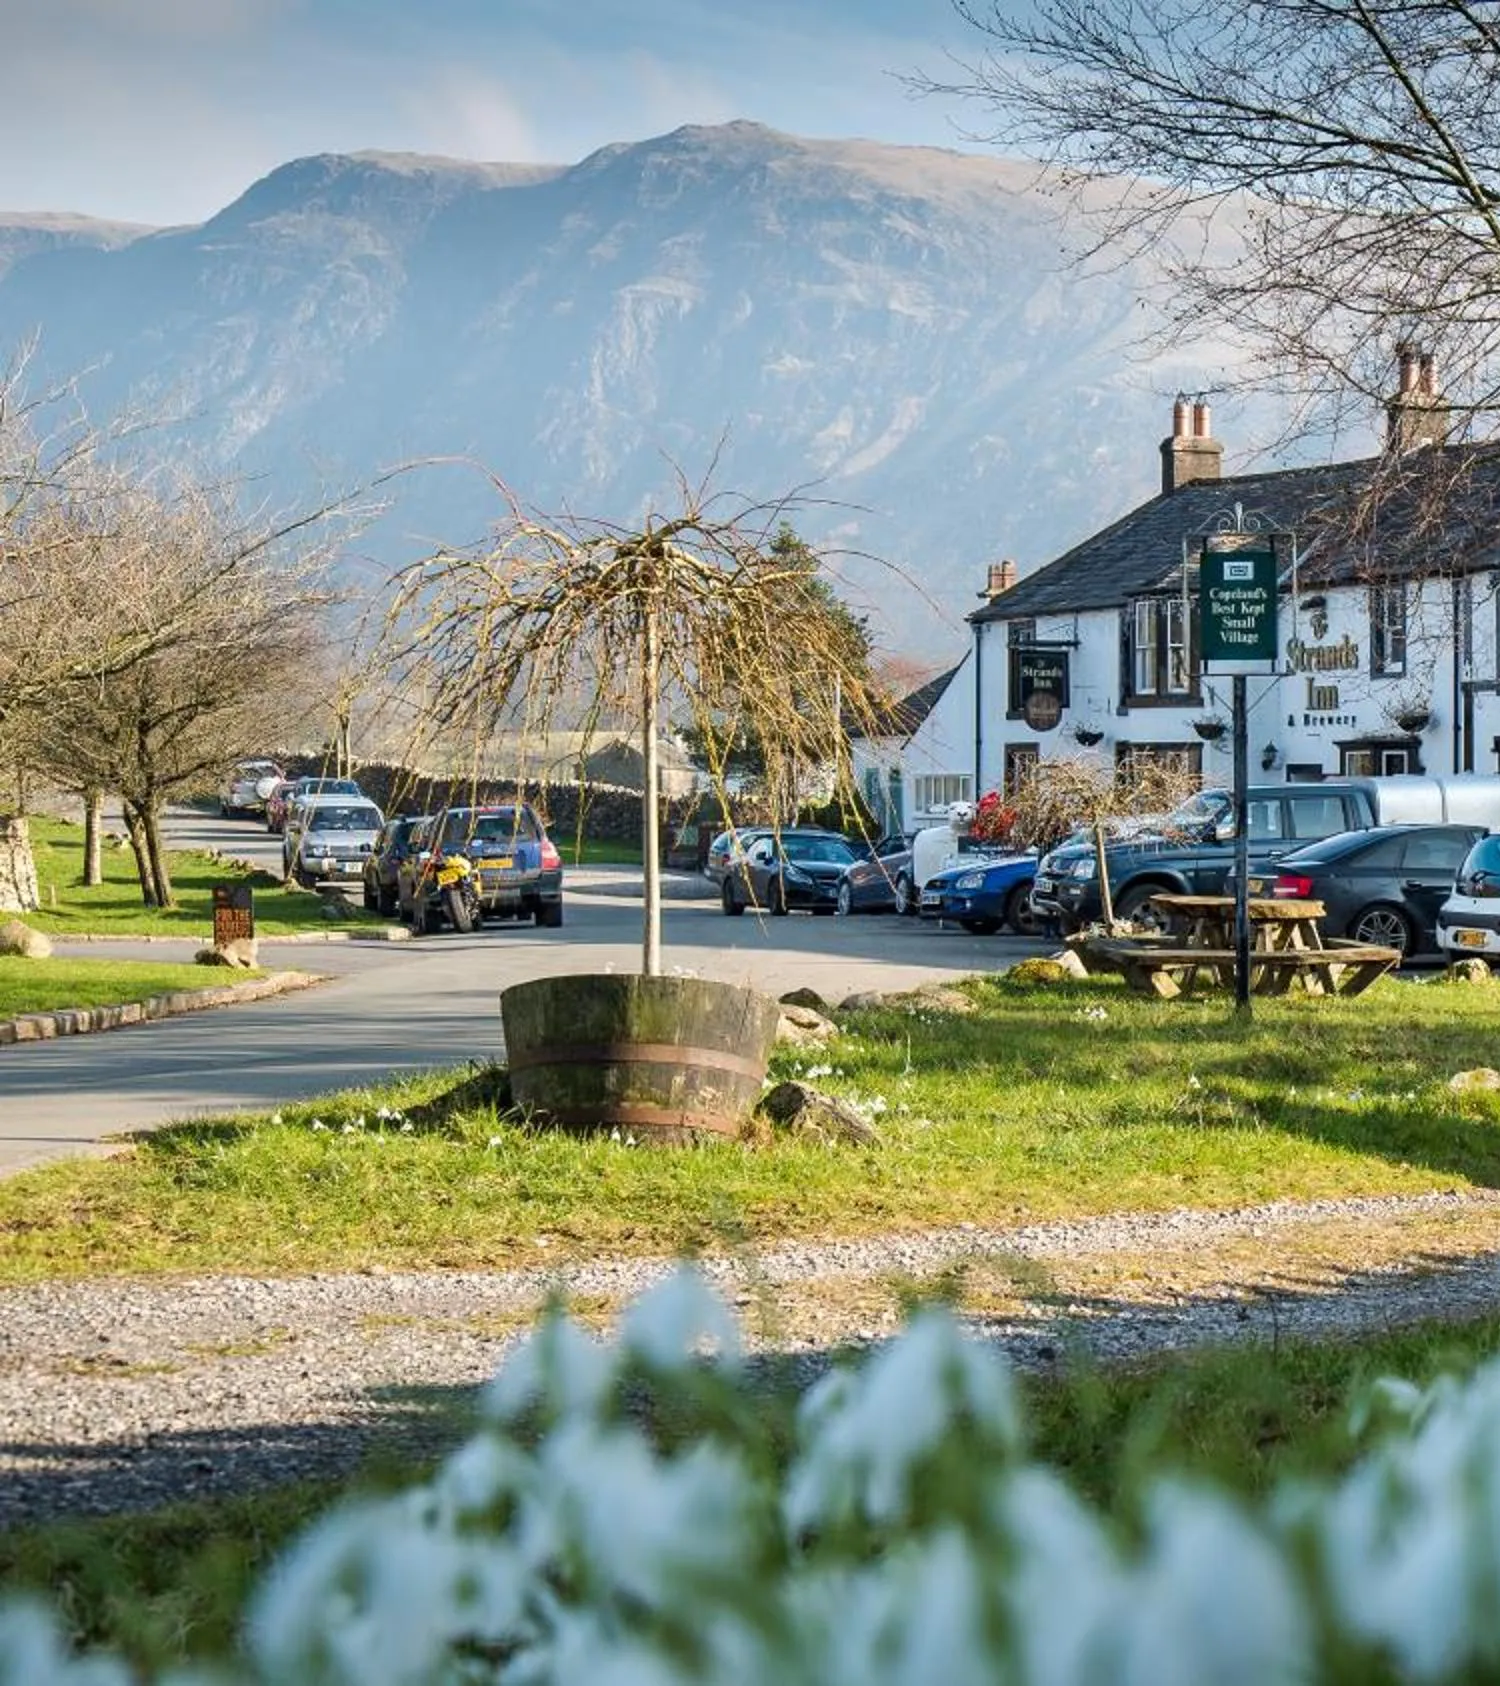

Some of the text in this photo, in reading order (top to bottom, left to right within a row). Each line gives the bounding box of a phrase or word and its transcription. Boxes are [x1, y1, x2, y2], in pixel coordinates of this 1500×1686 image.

[1209, 587, 1268, 601] Copeland's
[1211, 602, 1265, 616] Best Kept
[1222, 616, 1255, 629] Small
[1220, 631, 1259, 645] Village
[1286, 634, 1359, 672] Strands
[1305, 676, 1339, 710] Inn
[1303, 713, 1357, 728] Brewery
